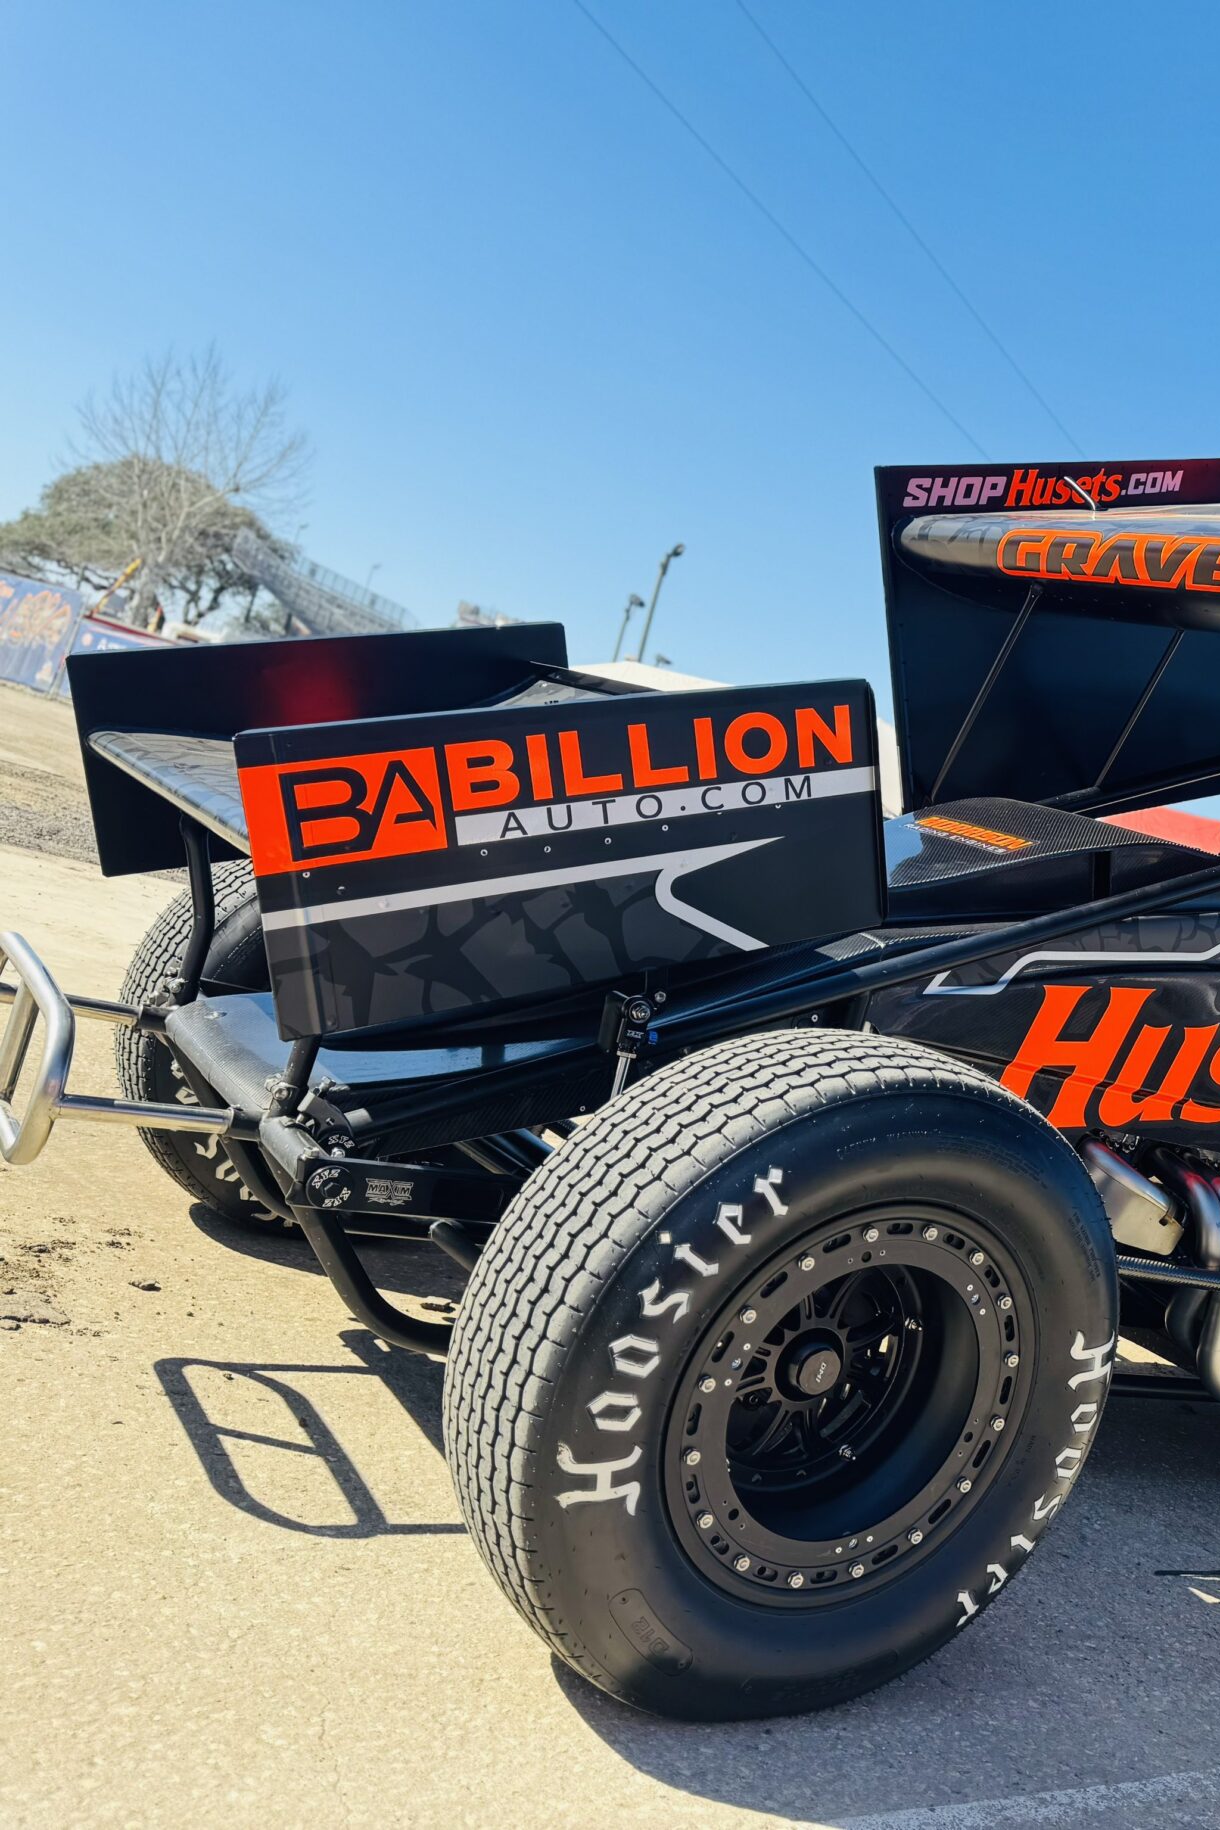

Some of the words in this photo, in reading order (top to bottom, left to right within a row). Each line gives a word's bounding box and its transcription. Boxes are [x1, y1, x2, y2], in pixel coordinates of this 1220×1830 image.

[444, 705, 852, 811] BILLION
[500, 775, 812, 839] AUTO.COM
[278, 759, 438, 861] BA
[365, 1178, 414, 1201] MAXIM
[556, 1166, 790, 1516] Hoosier
